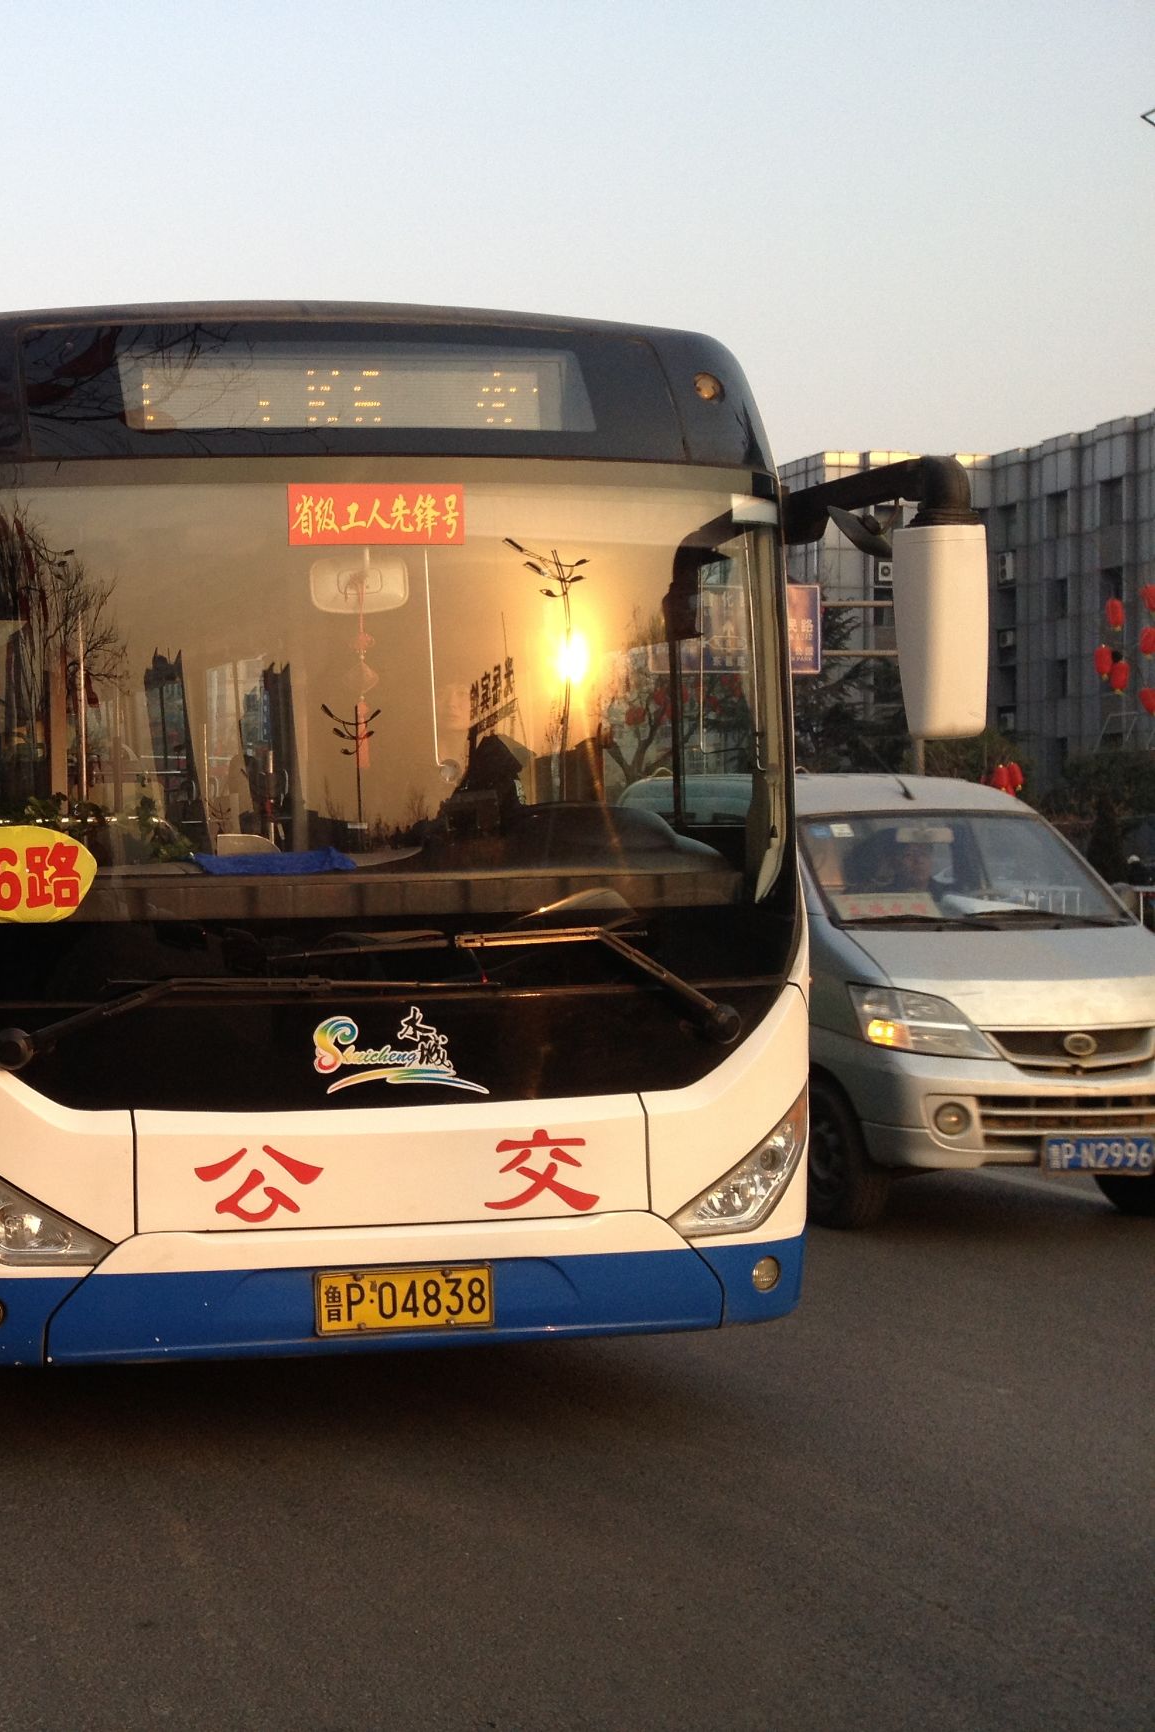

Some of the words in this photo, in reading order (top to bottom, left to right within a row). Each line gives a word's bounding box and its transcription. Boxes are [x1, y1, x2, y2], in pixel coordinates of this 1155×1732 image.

[292, 494, 459, 539] 省级工人先锋号
